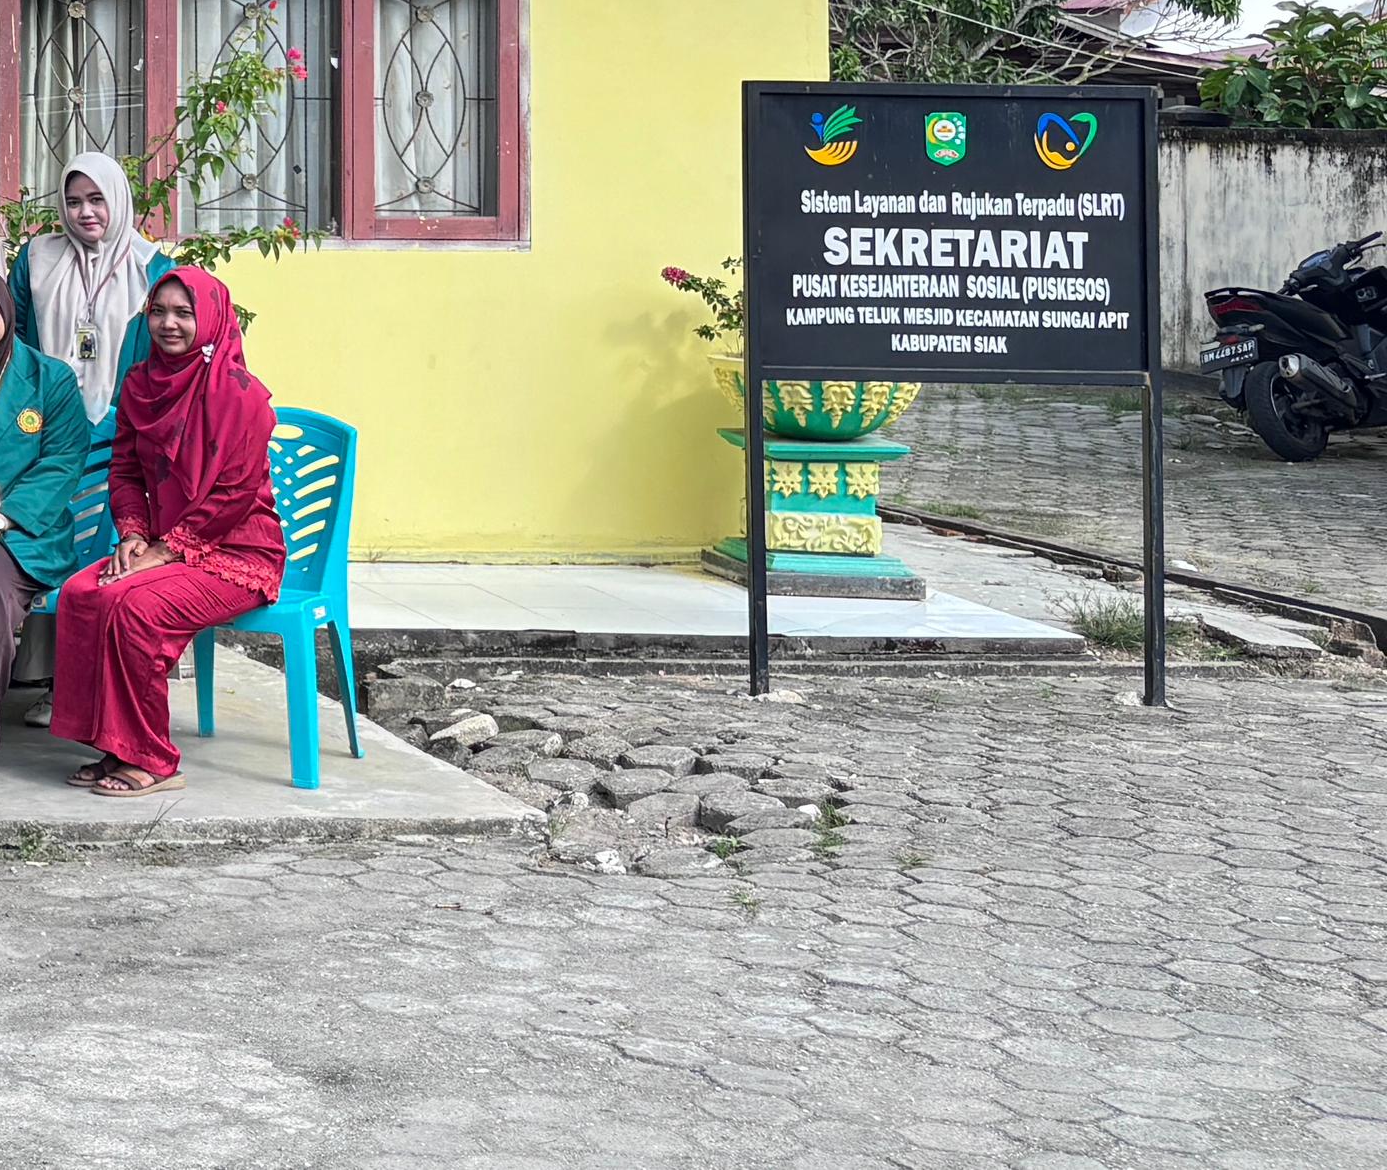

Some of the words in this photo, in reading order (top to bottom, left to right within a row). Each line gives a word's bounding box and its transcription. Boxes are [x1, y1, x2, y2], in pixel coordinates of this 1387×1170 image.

[800, 190, 850, 214] Sistem
[854, 191, 916, 219] Layanan
[919, 190, 947, 214] dan
[952, 192, 1013, 221] Rujukan
[1015, 193, 1075, 221] Terpadu
[1078, 193, 1125, 221] (SLRT)
[823, 227, 1089, 270] SEKRETARIAT
[792, 274, 837, 298] PUSAT
[840, 275, 959, 299] KESEJAHTERAAN
[966, 276, 1020, 300] SOSIAL
[1022, 276, 1110, 305] (PUSKESOS)
[786, 306, 855, 326] KAMPUNG
[857, 306, 901, 325] TELUK
[903, 307, 954, 326] MESJID
[956, 308, 1039, 329] KECAMATAN
[1042, 310, 1095, 329] SUNGAI
[1098, 311, 1129, 330] APIT
[891, 333, 971, 353] KABUPATEN
[974, 334, 1008, 354] SIAK
